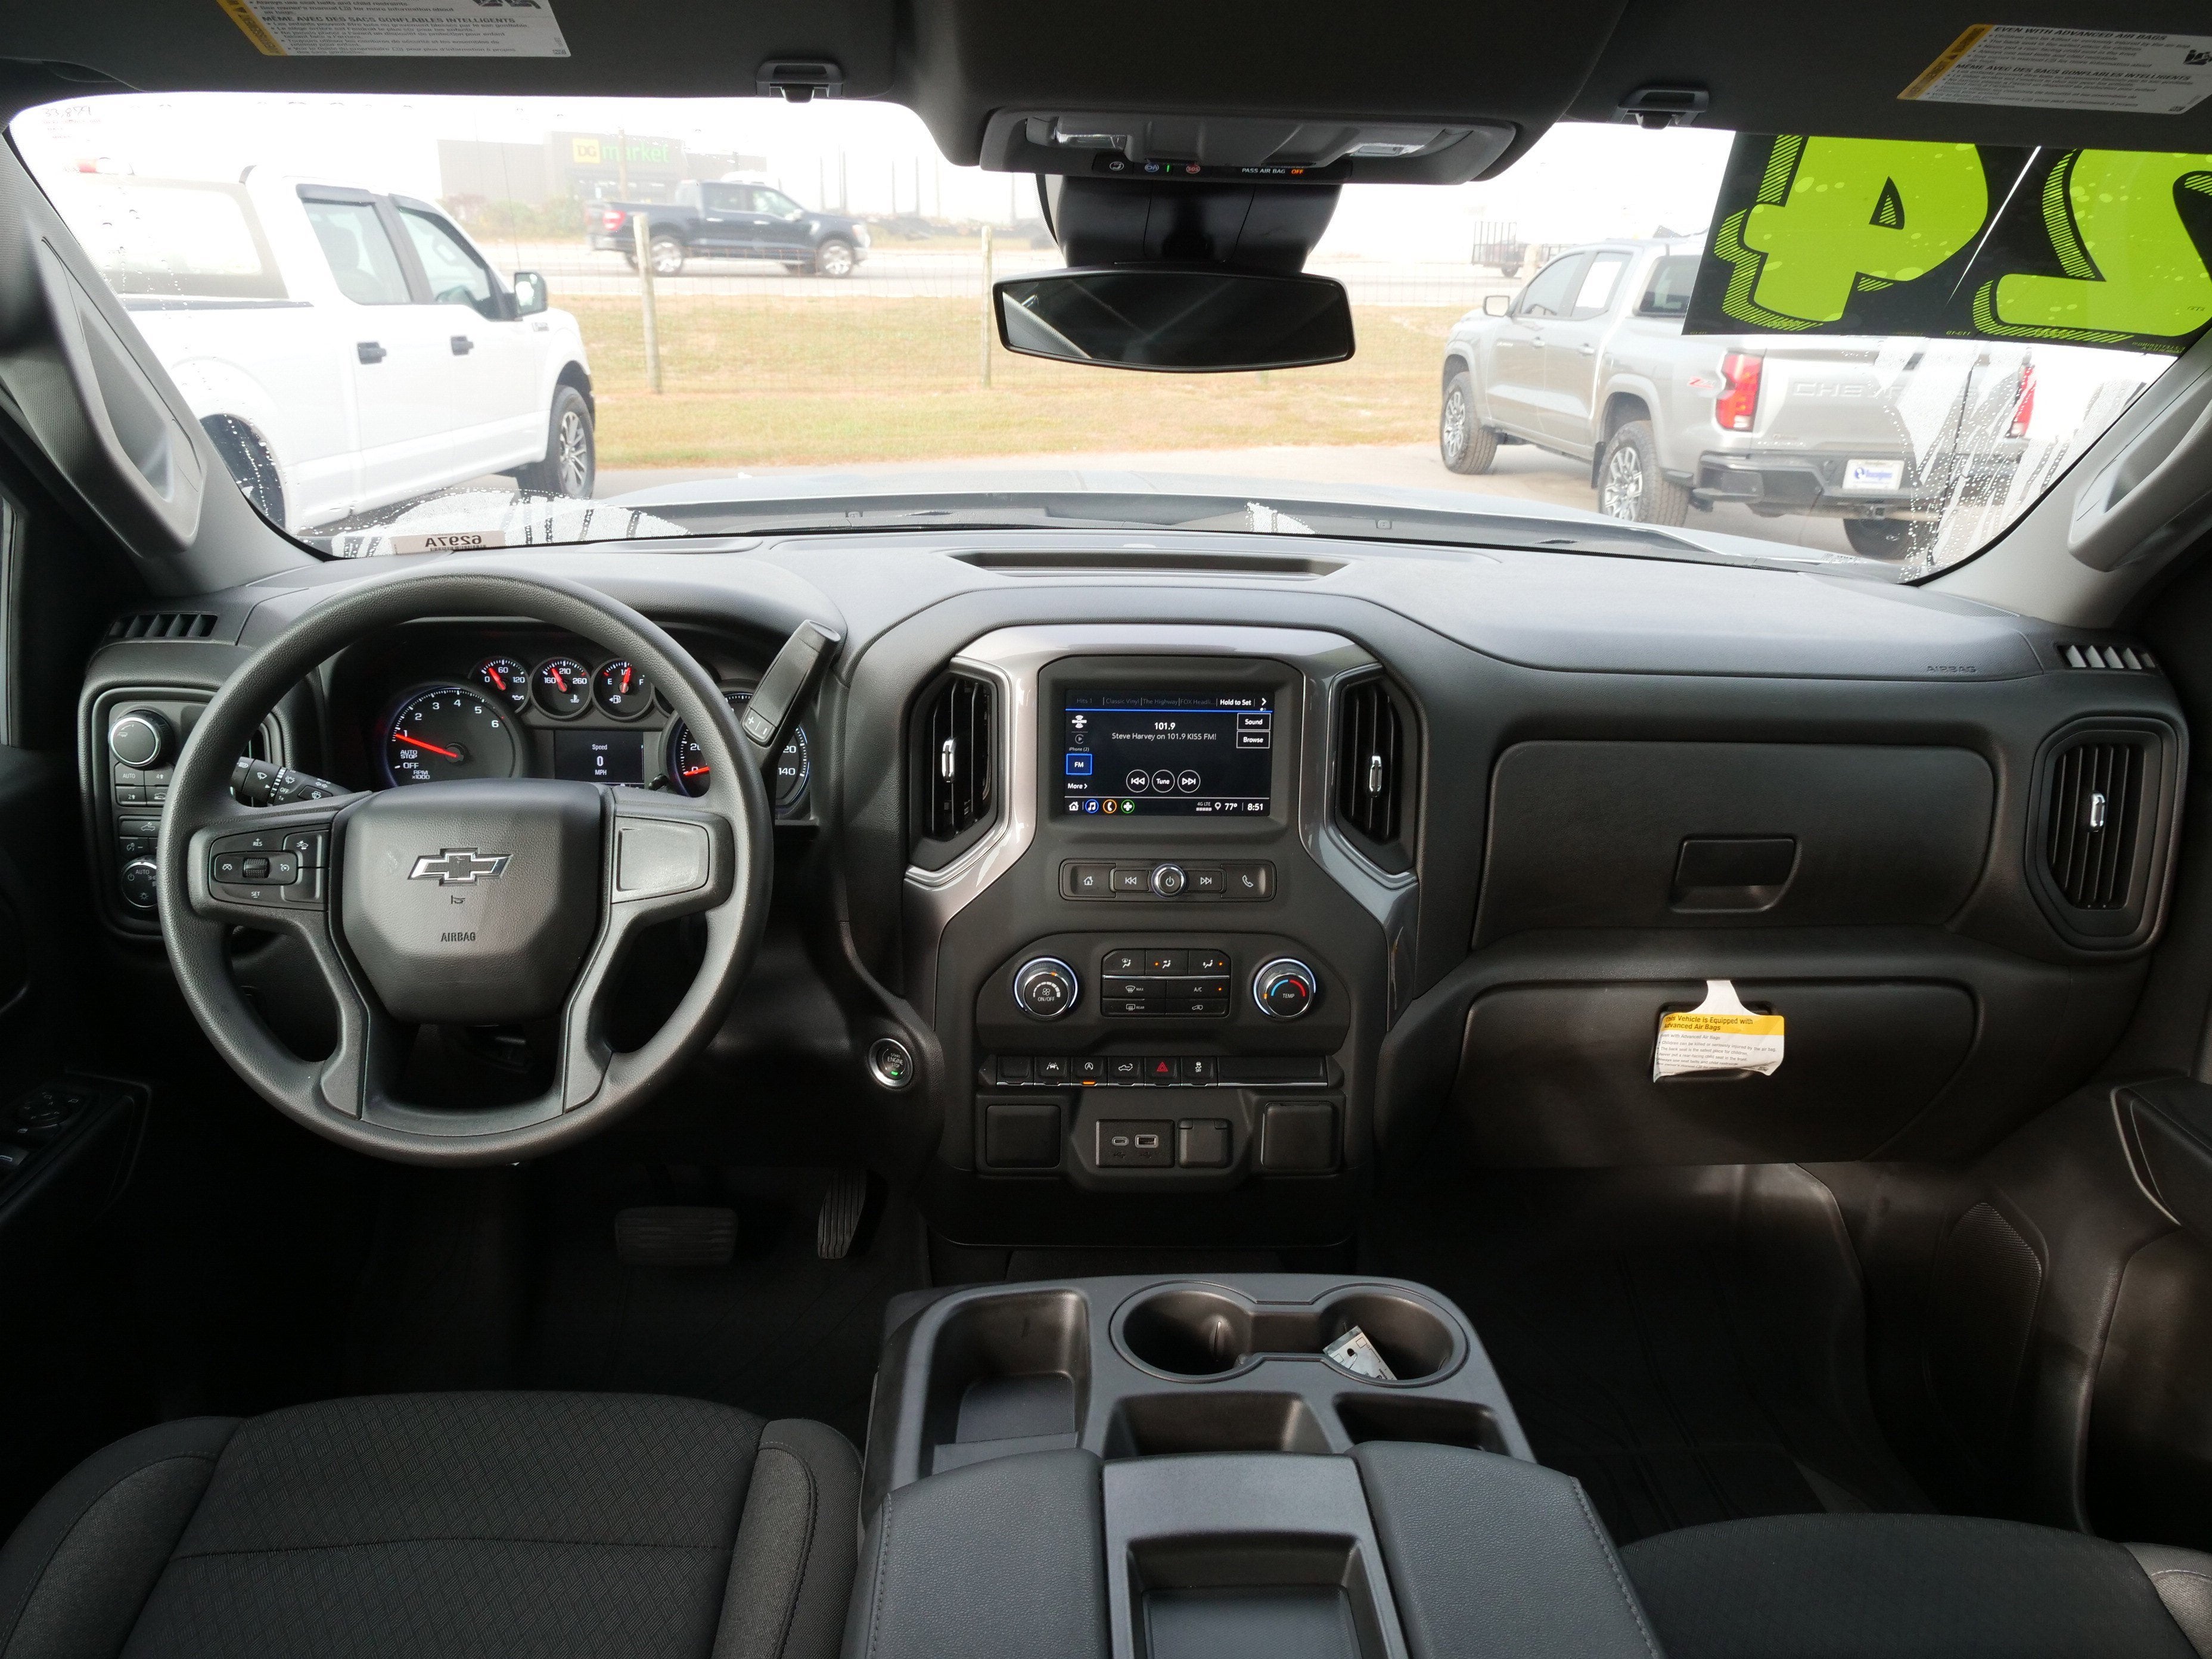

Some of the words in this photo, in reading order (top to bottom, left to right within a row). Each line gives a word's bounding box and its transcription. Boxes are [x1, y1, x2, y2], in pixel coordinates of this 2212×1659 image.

[1154, 722, 1176, 731] 101.9
[1132, 732, 1155, 741] Harvey
[597, 756, 604, 767] 0
[778, 767, 796, 775] 140
[1247, 803, 1264, 811] 8:51
[440, 931, 476, 942] AIRBAG
[1710, 1017, 1738, 1025] Equipped
[887, 1057, 904, 1065] ENGINE
